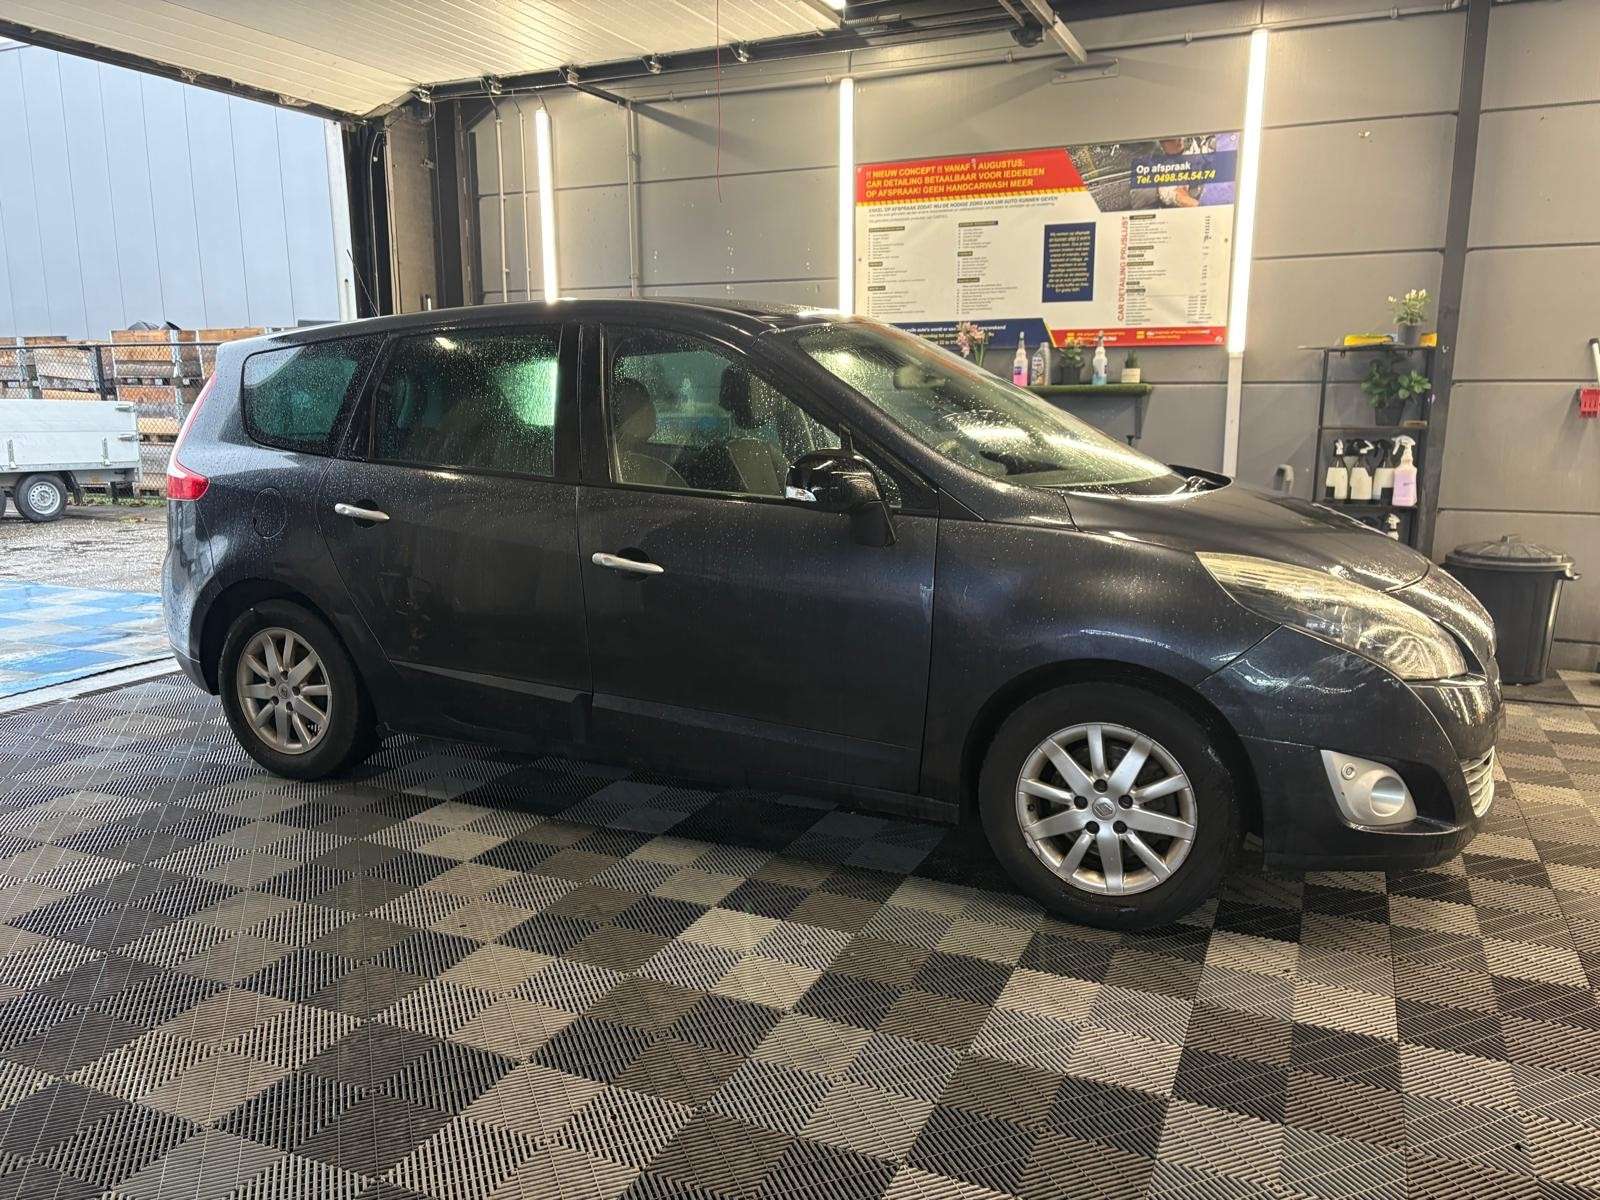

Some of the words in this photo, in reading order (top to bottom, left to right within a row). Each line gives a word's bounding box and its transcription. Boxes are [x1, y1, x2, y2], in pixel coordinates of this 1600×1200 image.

[866, 178, 882, 188] CAR
[883, 176, 922, 187] DETAILING
[924, 173, 976, 185] BETAALBAAR
[978, 170, 1002, 181] VOOR
[1003, 167, 1045, 178] IEDEREEN
[872, 168, 898, 178] NIEUW
[899, 166, 937, 177] CONCEPT
[944, 163, 970, 173] VANAF
[978, 158, 1025, 170] AUGUSTUS:
[1136, 165, 1150, 175] Op
[1151, 161, 1191, 173] afspraak
[1136, 175, 1151, 184] Tel.
[1153, 170, 1216, 183] 0498.54.54.74
[866, 188, 877, 198] OP
[878, 185, 921, 197] AFSPRAAK!
[922, 184, 945, 194] GEEN
[946, 181, 1009, 193] HANDCARWASH
[1010, 178, 1033, 188] MEER
[1119, 216, 1129, 260] PRIJSLIJST
[1118, 262, 1127, 302] DETAILING
[1117, 303, 1125, 321] CAR
